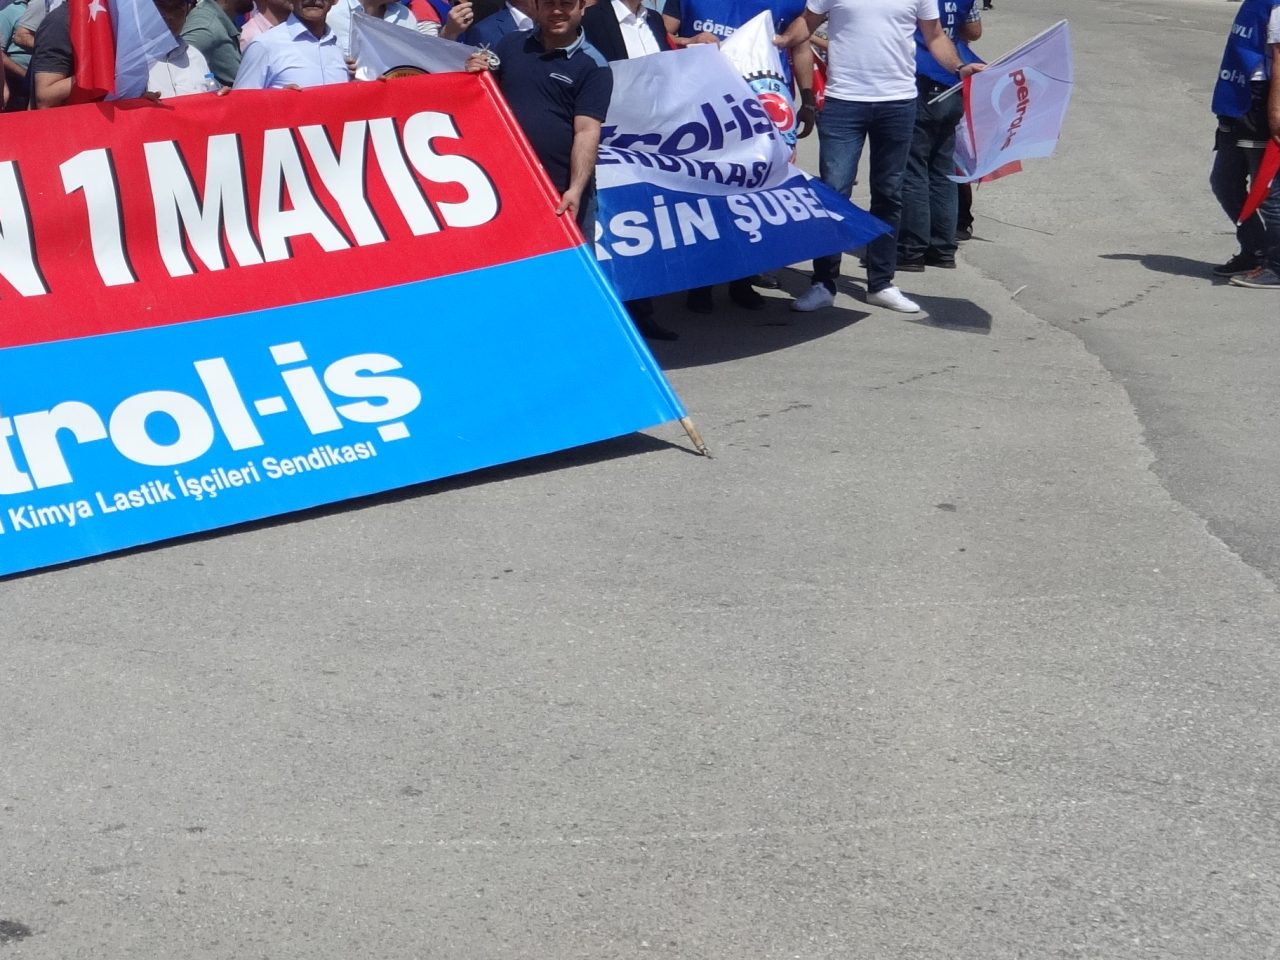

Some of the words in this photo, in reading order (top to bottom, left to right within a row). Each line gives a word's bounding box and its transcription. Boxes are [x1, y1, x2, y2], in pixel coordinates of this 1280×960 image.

[944, 2, 957, 13] KA
[60, 148, 137, 287] 1
[143, 111, 501, 278] MAYIS
[9, 501, 94, 532] Kimya
[96, 479, 176, 514] Lastik
[174, 462, 260, 501] İşçileri
[262, 440, 377, 480] Sendikası
